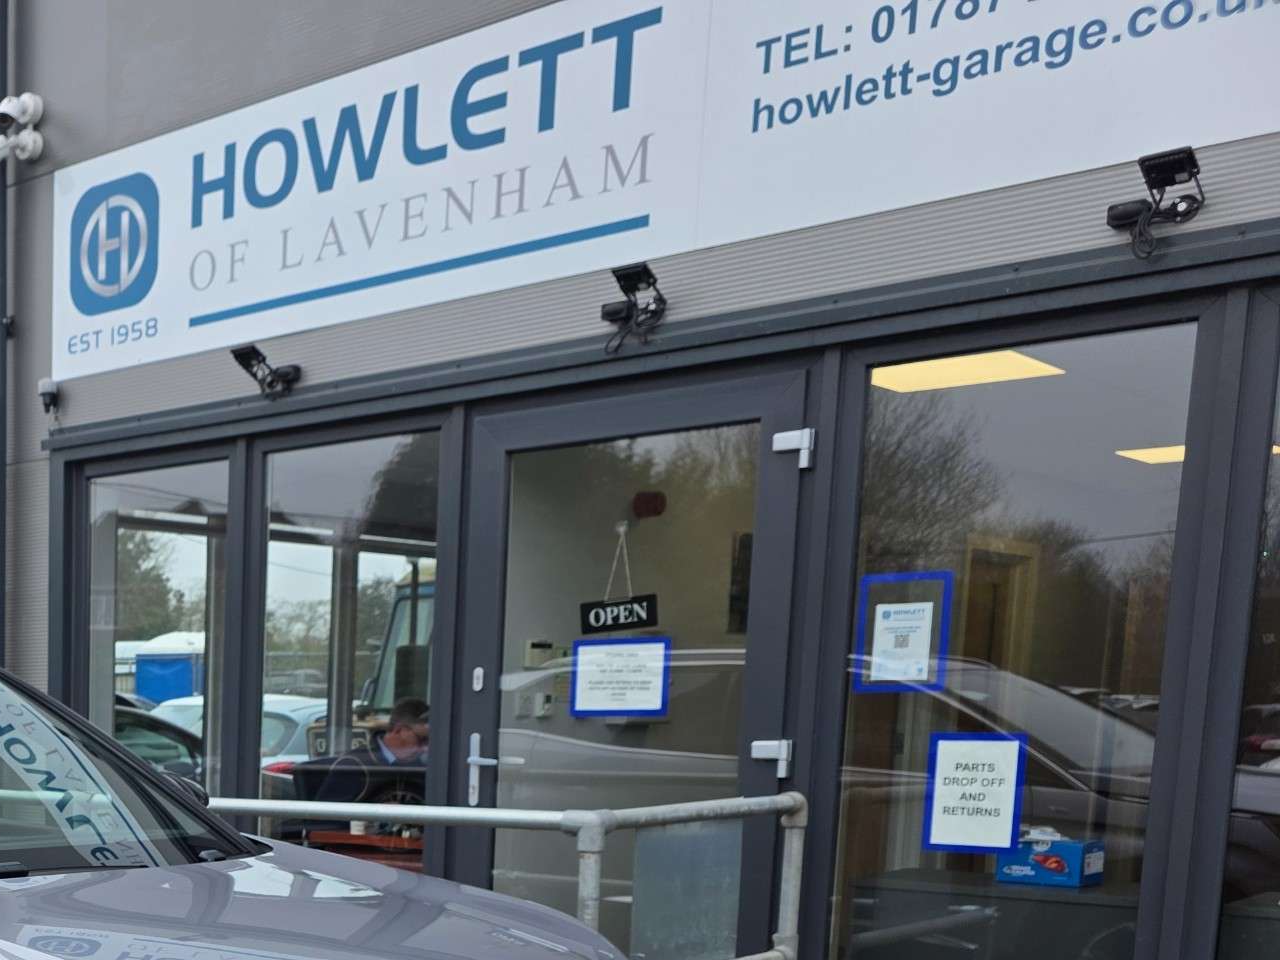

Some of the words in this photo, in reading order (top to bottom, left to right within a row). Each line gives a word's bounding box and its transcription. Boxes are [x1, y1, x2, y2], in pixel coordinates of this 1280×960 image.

[755, 23, 854, 75] TEL:
[750, 0, 1280, 134] howlett-garage.co.u
[190, 6, 663, 229] HOWLETT
[189, 240, 250, 292] OF
[278, 131, 656, 273] LAVENHAM
[67, 329, 103, 355] EST
[110, 317, 159, 346] 1958
[588, 601, 648, 628] OPEN
[943, 777, 978, 787] DROP
[980, 777, 1006, 788] OFF
[955, 762, 996, 773] PARTS
[942, 805, 1001, 818] RETURNS
[959, 791, 987, 802] AND
